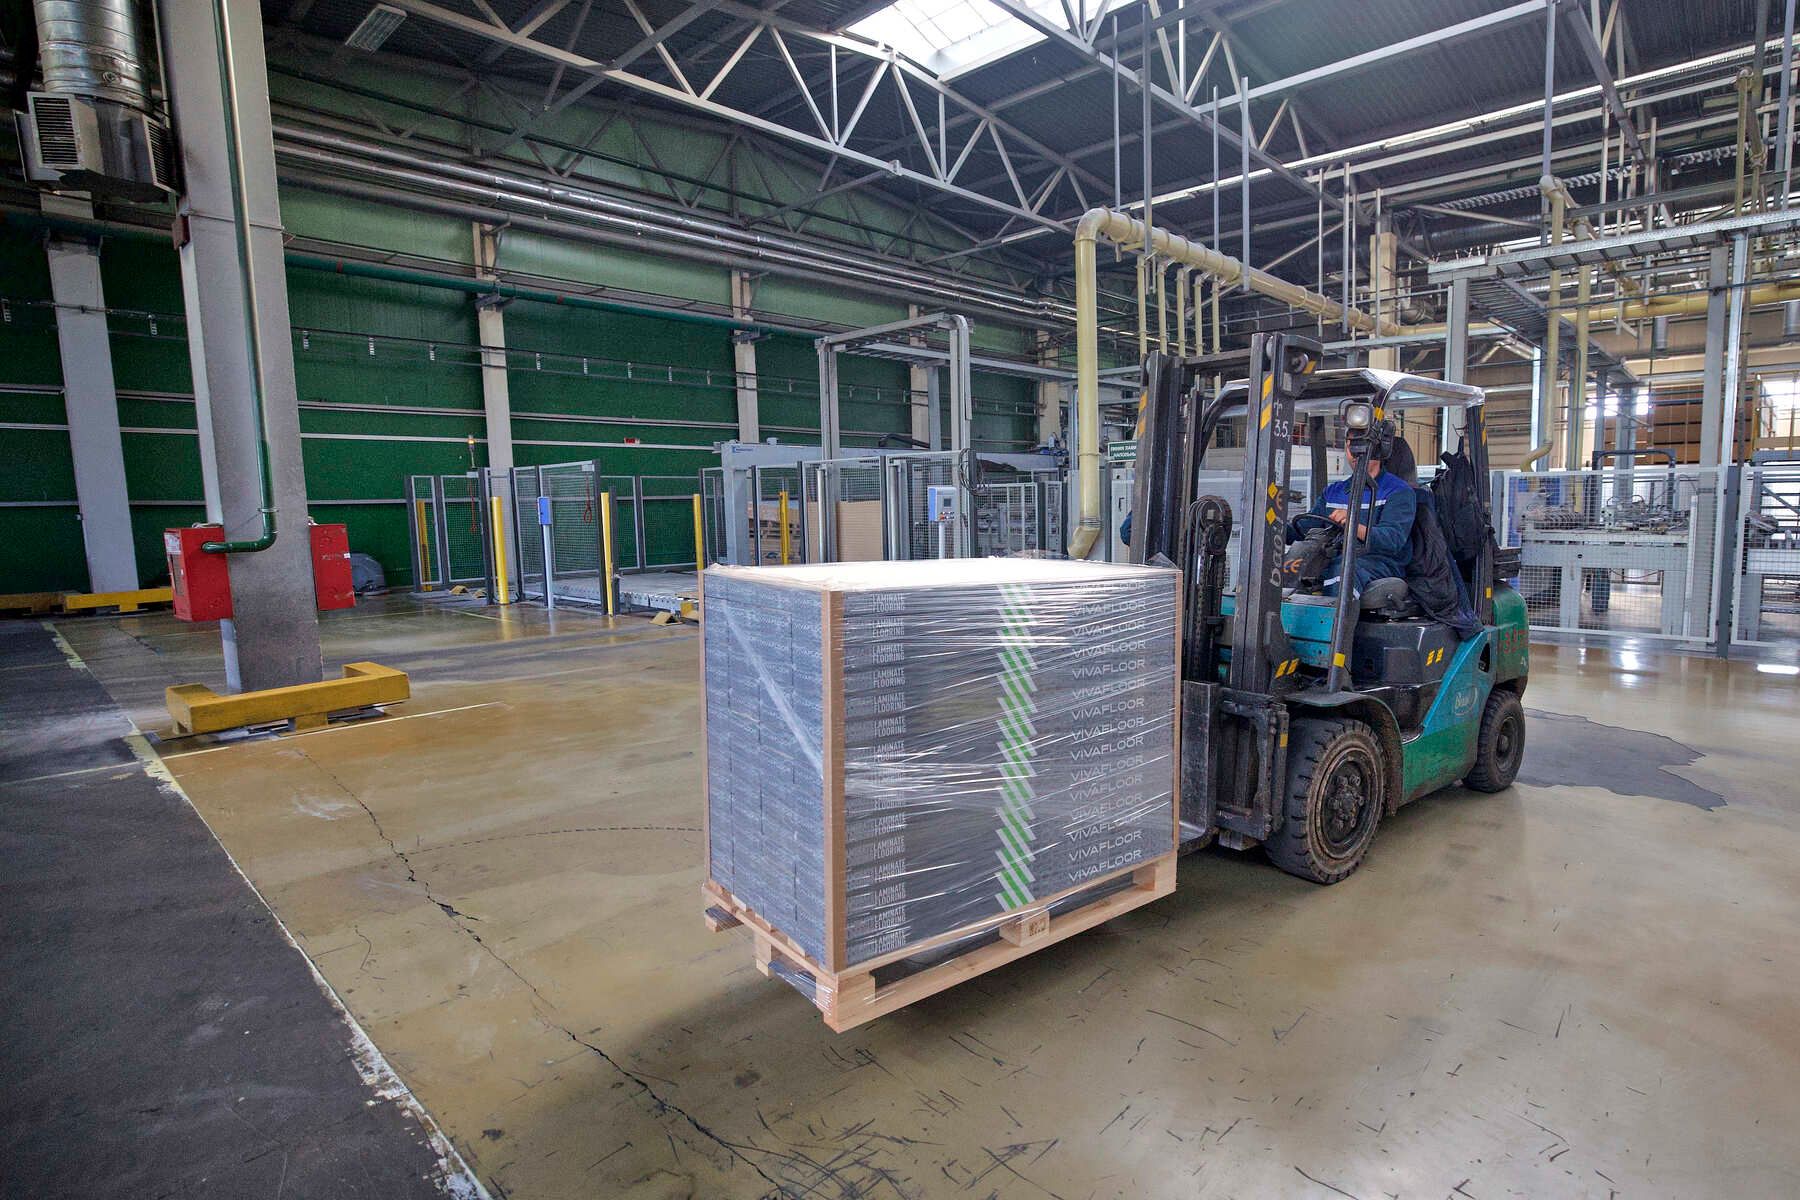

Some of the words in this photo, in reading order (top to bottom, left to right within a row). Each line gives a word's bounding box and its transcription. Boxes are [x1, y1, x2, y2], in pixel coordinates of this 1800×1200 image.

[1072, 641, 1146, 658] VIVAFLOOR
[873, 667, 905, 680] LAMINATE
[1072, 660, 1146, 680] VIVAFLOOR
[873, 676, 906, 689] FLOORING
[1072, 679, 1145, 699] VIVAFLOOR
[873, 692, 905, 704] LAMINATE
[873, 701, 906, 714] FLOORING
[1072, 698, 1145, 721] VIVAFLOOR
[874, 716, 906, 729] LAMINATE
[1072, 717, 1145, 741] VIVAFLOOR
[874, 726, 907, 738] FLOORING
[873, 740, 905, 754] LAMINATE
[1070, 736, 1144, 761] VIVAFLOOR
[1070, 755, 1144, 782] VIVAFLOOR
[1070, 775, 1143, 801] VIVAFLOOR
[873, 836, 905, 850] LAMINATE
[1069, 831, 1142, 861] VIVAFLOOR
[873, 846, 906, 861] FLOORING
[874, 858, 906, 874] LAMINATE
[1068, 850, 1142, 881] VIVAFLOOR
[874, 905, 906, 923] LAMINATE
